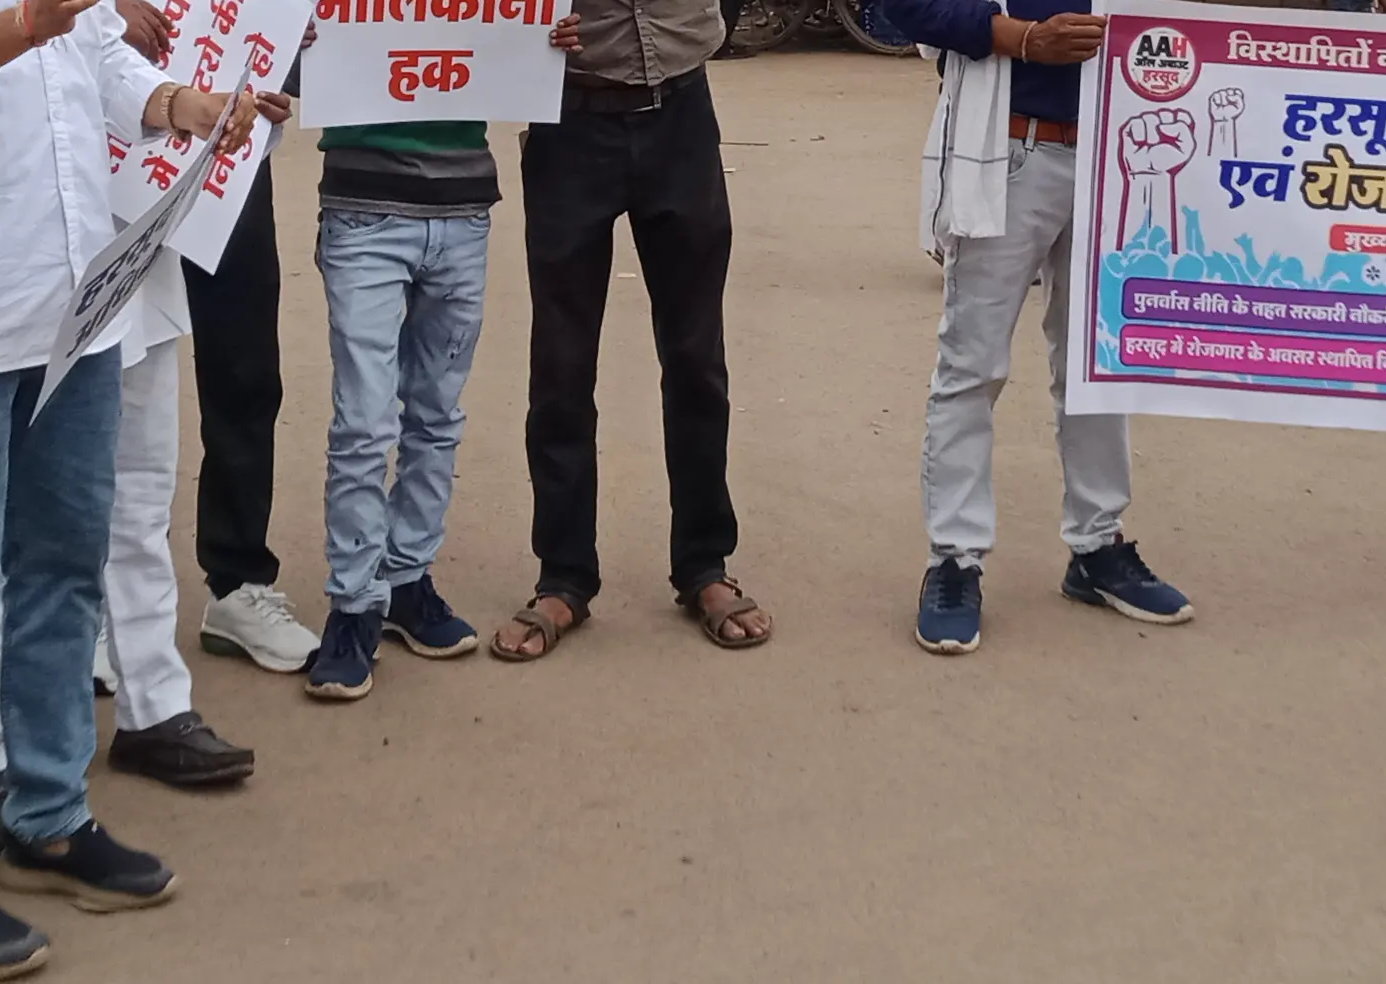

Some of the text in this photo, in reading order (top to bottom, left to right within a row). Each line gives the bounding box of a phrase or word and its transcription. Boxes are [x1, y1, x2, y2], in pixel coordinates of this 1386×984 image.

[1136, 34, 1189, 59] AAH
[1227, 30, 1373, 69] विस्थापितों
[388, 49, 474, 102] हक
[1142, 69, 1180, 86] हरसूद
[1219, 145, 1296, 210] एवं
[1132, 290, 1191, 314] पुनर्वास
[1192, 293, 1229, 314] नीति
[1231, 296, 1250, 316] के
[1252, 302, 1287, 320] तहत
[1289, 299, 1347, 323] सरकारी
[1124, 336, 1167, 360] हरसूद
[1169, 333, 1184, 355] में
[1186, 335, 1244, 360] रोजगार
[1246, 341, 1266, 362] के
[1267, 347, 1315, 366] अवसर
[1317, 344, 1374, 370] स्थापित
